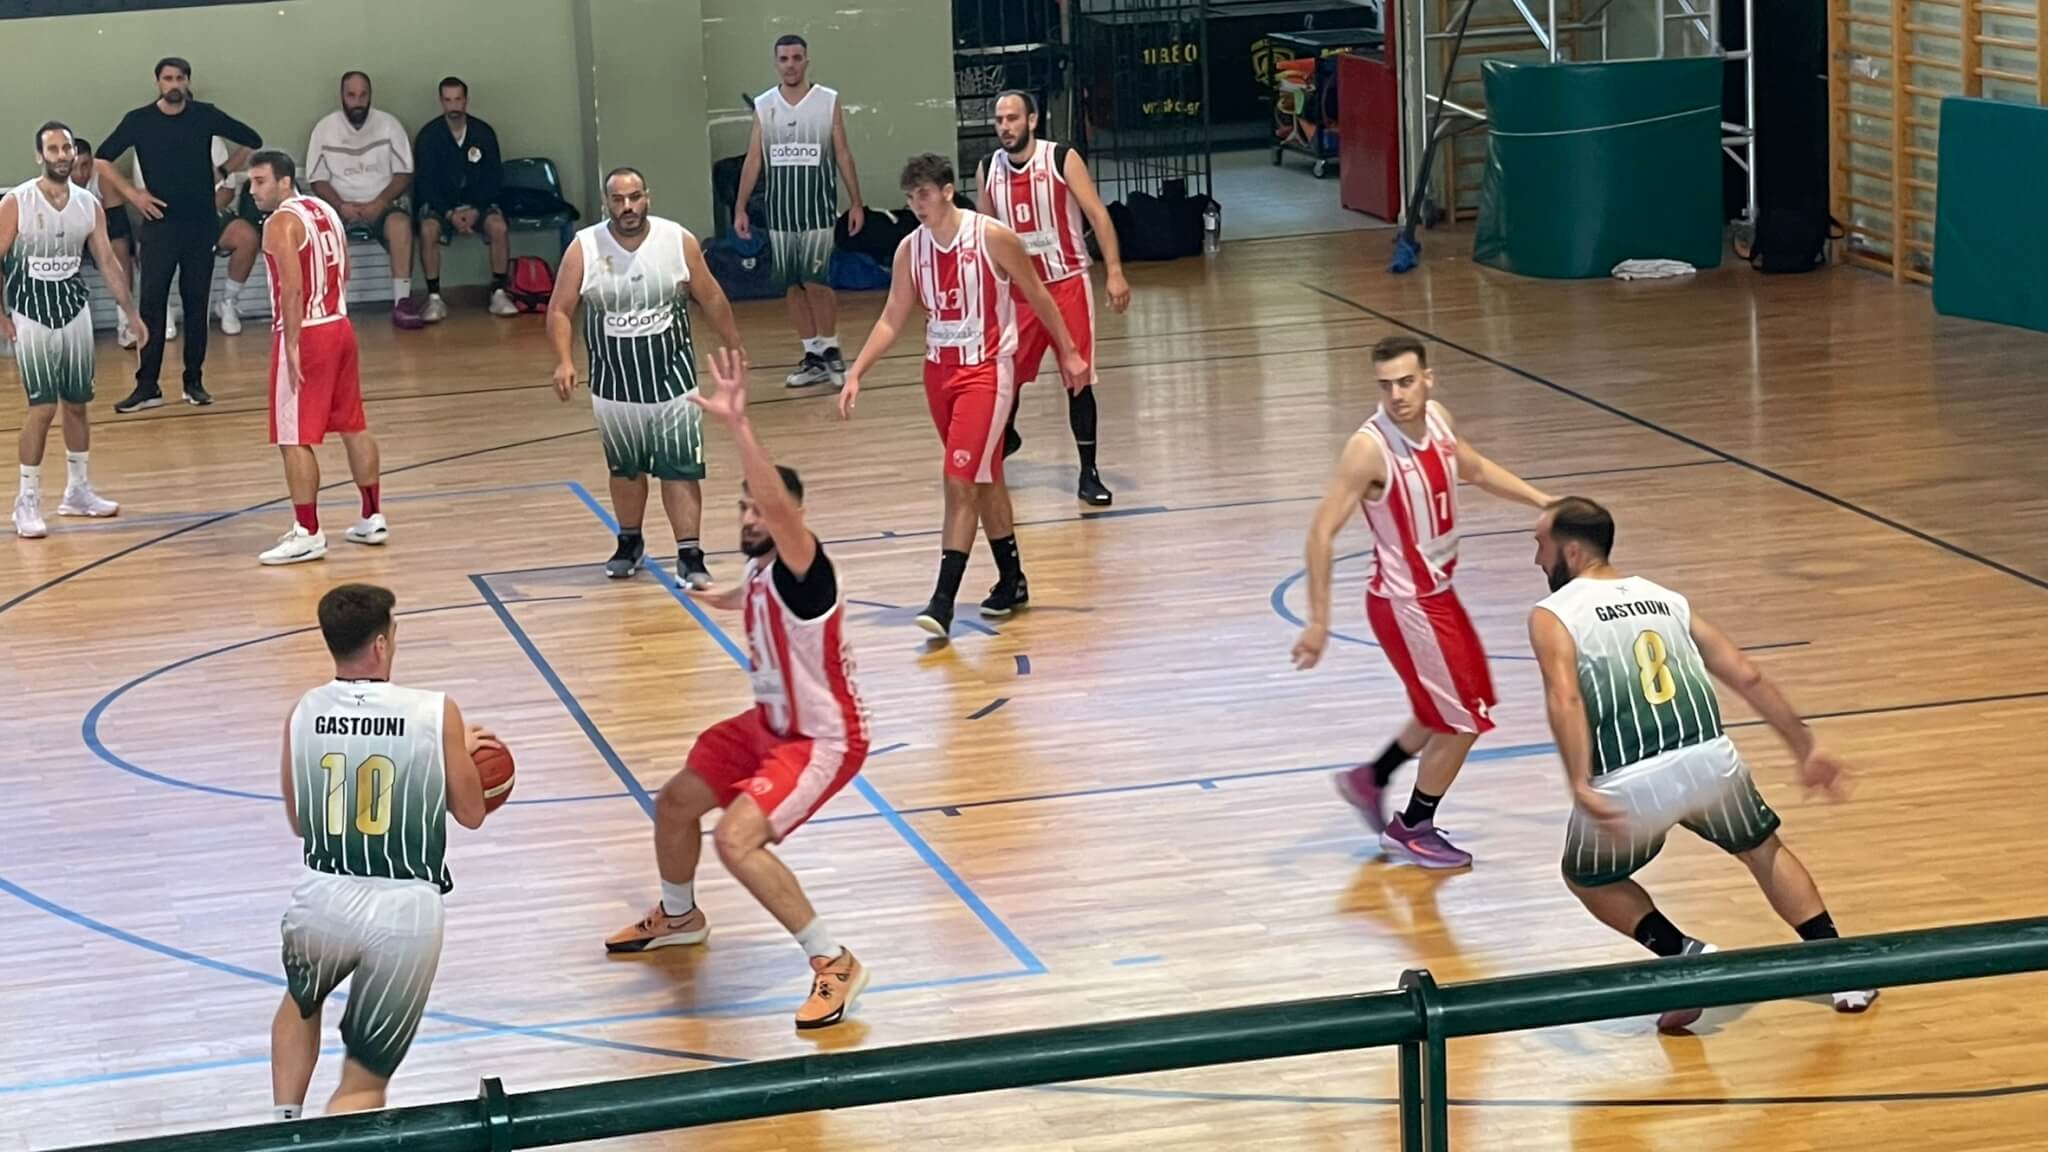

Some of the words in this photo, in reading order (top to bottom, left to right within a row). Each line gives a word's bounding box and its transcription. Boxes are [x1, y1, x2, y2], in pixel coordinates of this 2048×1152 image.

[320, 230, 340, 267] 9
[1595, 600, 1671, 622] GASTOUNI
[1632, 629, 1676, 705] 8
[315, 715, 405, 737] GASTOUNI
[320, 752, 397, 836] 10
